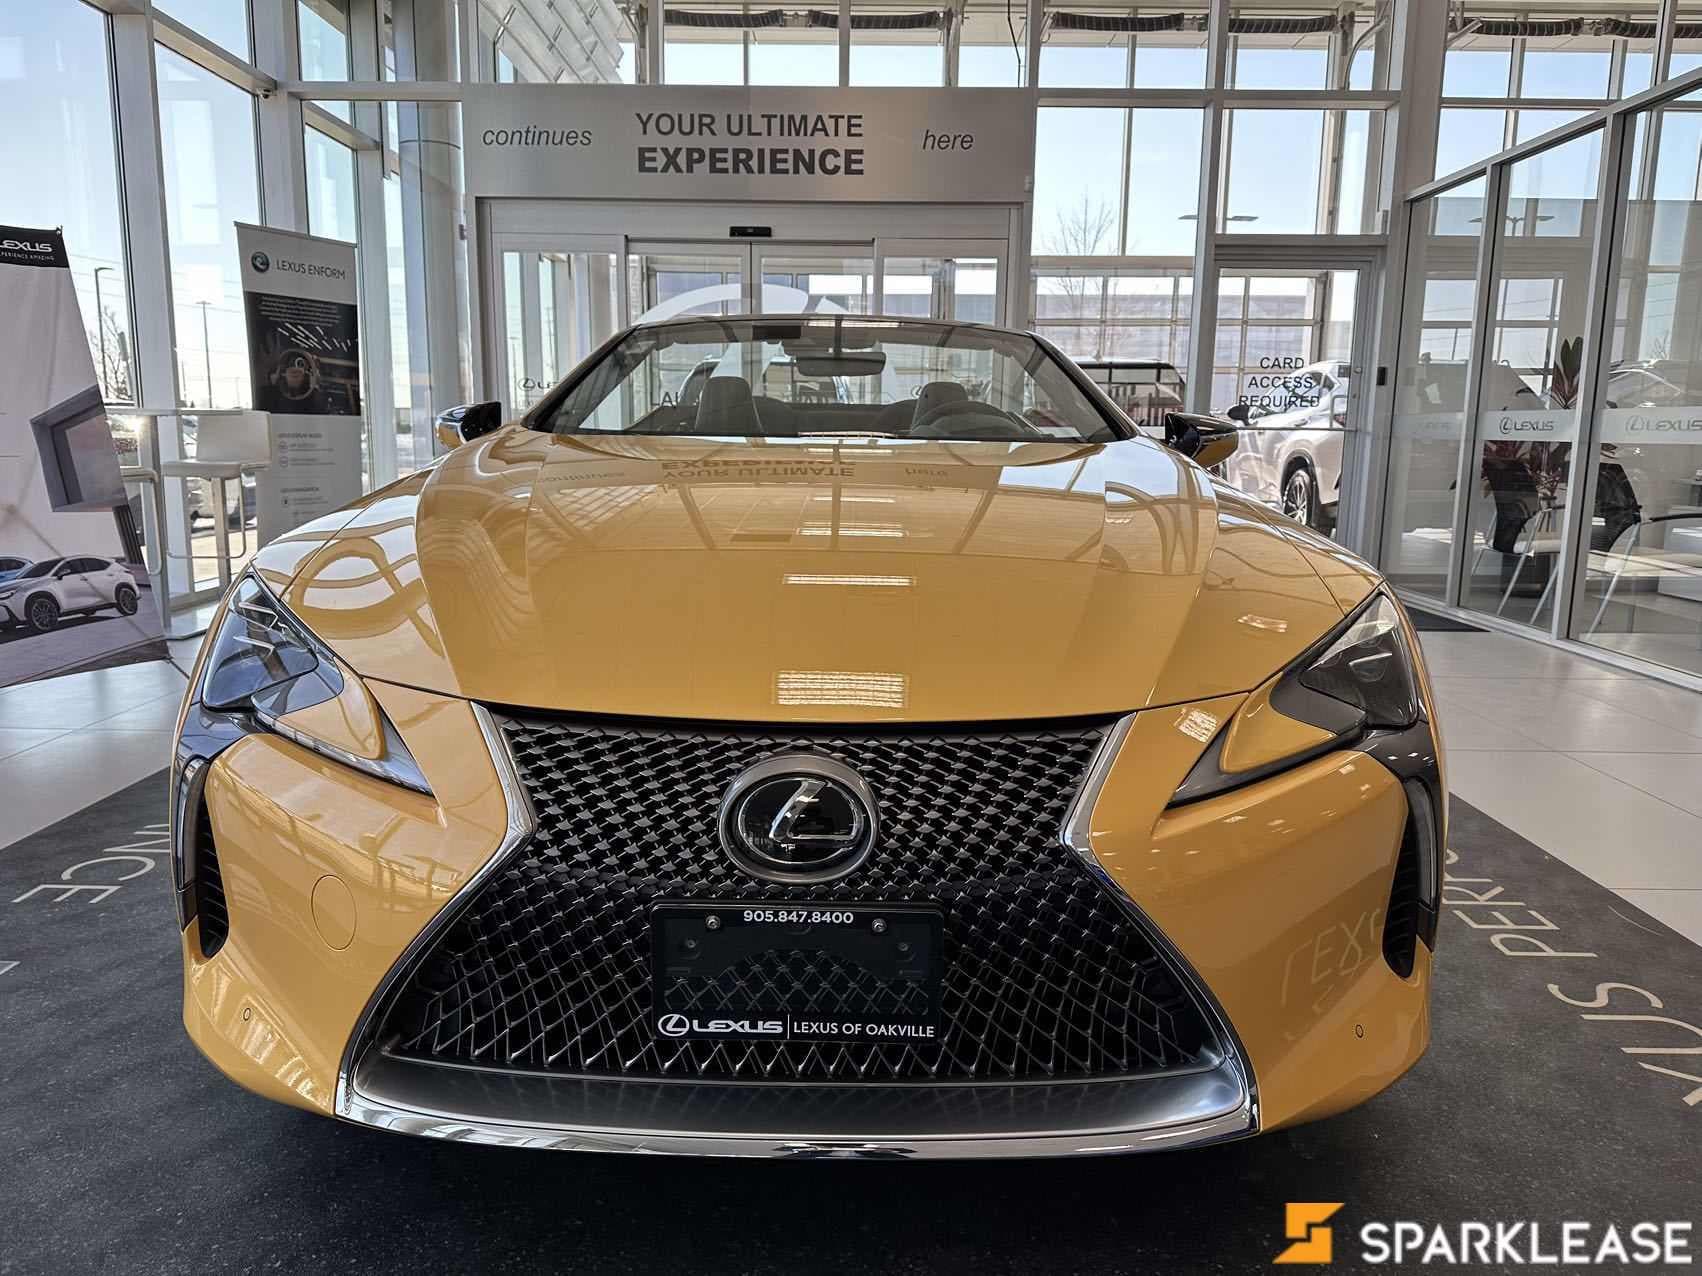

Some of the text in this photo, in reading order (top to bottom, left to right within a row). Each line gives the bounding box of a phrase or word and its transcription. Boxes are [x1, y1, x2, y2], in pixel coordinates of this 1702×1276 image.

[636, 113, 863, 138] YOUR ULTIMATE
[482, 125, 593, 149] continues
[922, 129, 974, 151] here
[637, 147, 864, 176] EXPERIENCE
[0, 240, 53, 252] EXUS
[276, 259, 346, 280] LEXUS ENFORM
[1260, 357, 1304, 369] CARD
[1247, 376, 1313, 389] ACCESS
[1239, 395, 1320, 409] REQUIRED
[1514, 421, 1555, 431] LEXUS
[1646, 419, 1702, 432] LEXUS
[743, 910, 854, 924] 905.847.8400
[693, 1019, 784, 1034] LEXUS
[793, 1021, 935, 1038] LEXUS OF OAKVILLE
